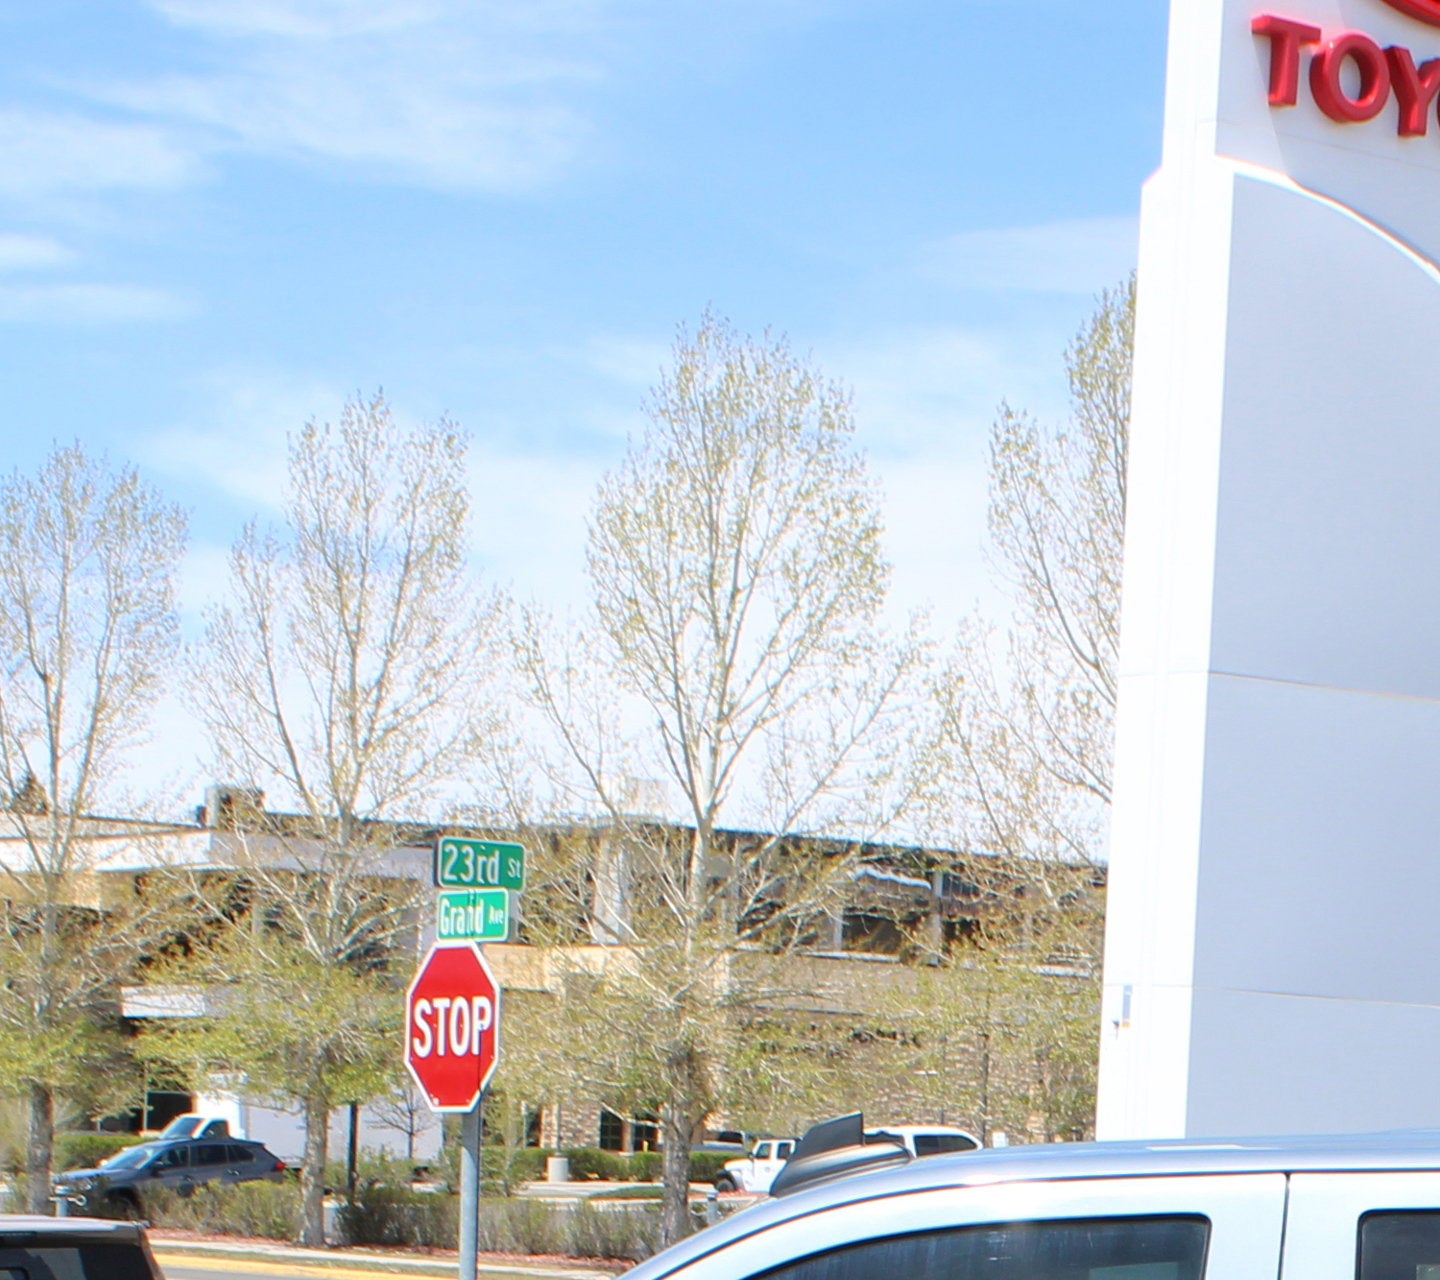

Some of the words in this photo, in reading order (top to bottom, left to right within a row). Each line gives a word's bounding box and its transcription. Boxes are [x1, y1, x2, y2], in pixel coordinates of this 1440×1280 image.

[443, 843, 500, 885] 23rd
[507, 858, 521, 879] St
[440, 898, 484, 936] Grand
[488, 904, 505, 926] Ave
[412, 996, 493, 1058] STOP
